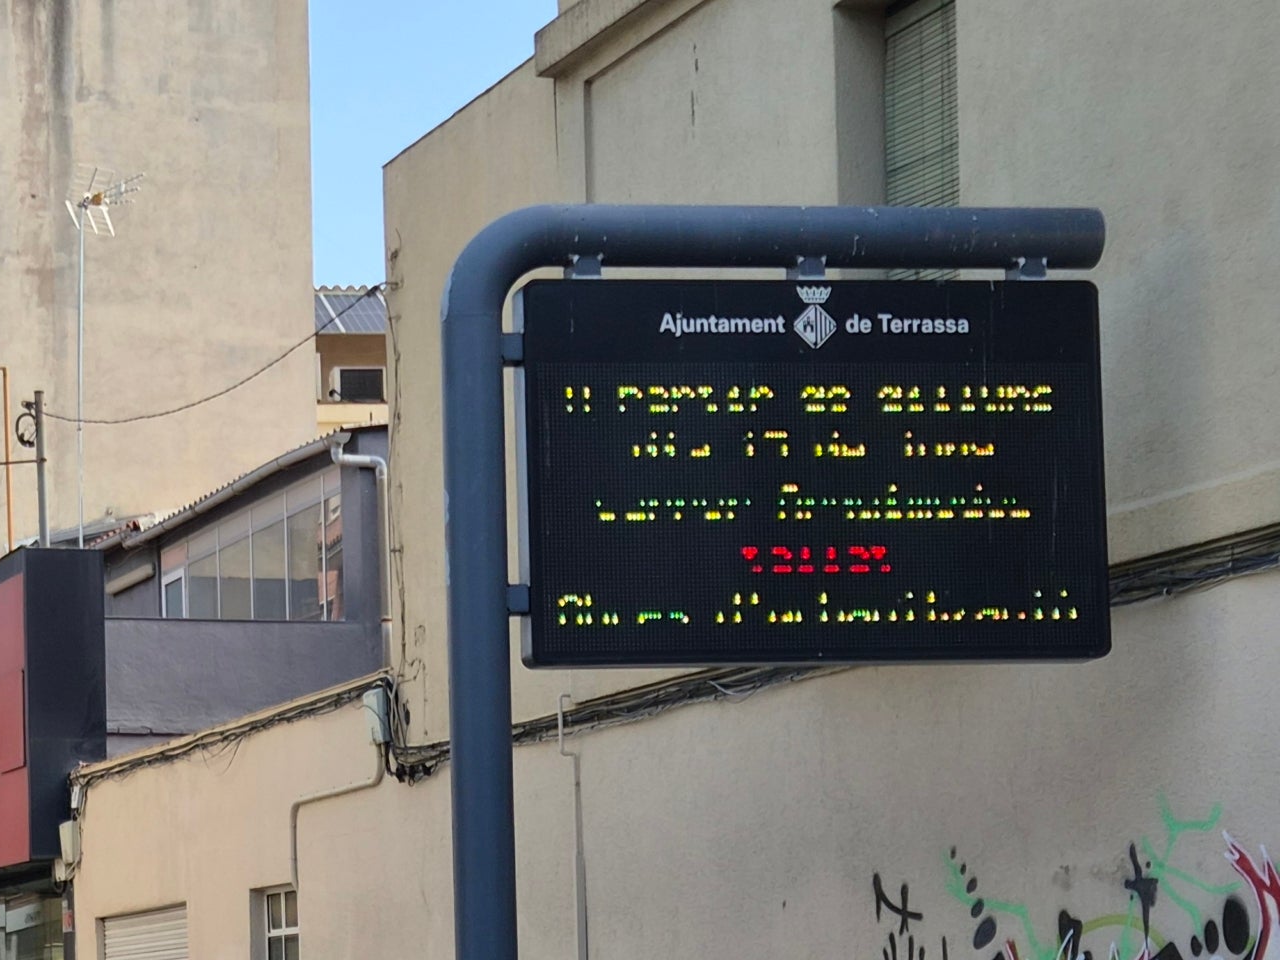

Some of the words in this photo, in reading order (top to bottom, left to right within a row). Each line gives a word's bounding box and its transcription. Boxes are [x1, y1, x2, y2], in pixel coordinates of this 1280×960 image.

[659, 312, 786, 338] Ajuntament
[845, 313, 872, 334] de
[877, 313, 969, 334] Terrassa
